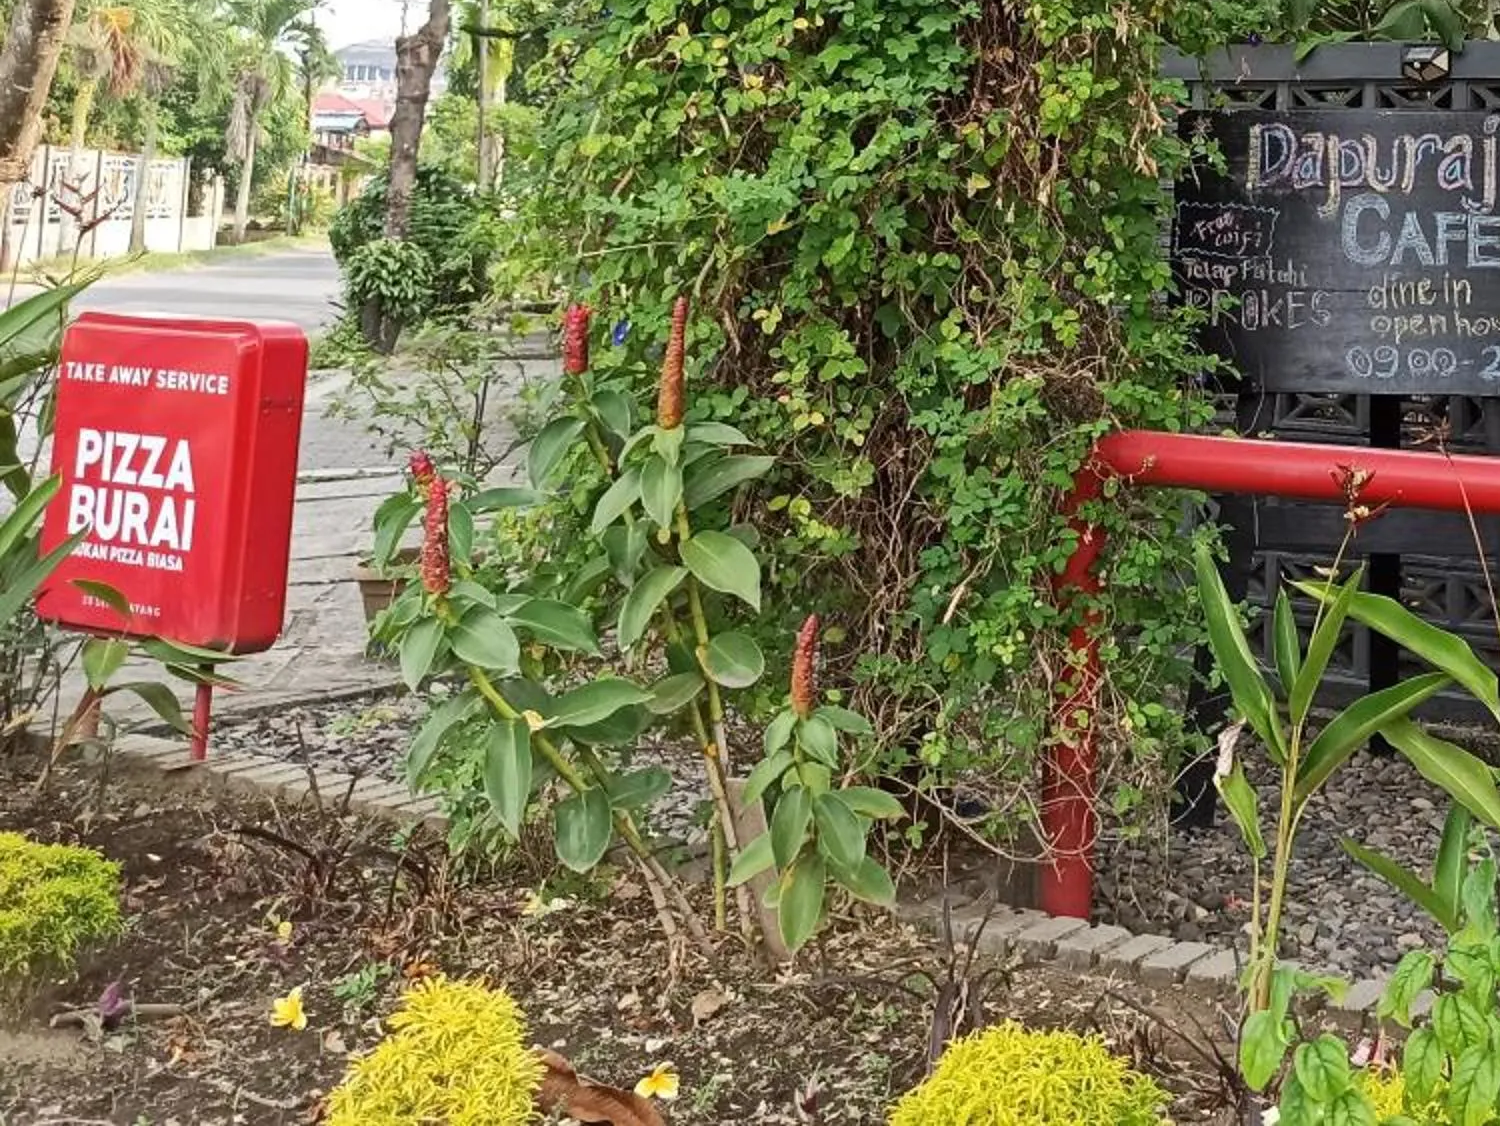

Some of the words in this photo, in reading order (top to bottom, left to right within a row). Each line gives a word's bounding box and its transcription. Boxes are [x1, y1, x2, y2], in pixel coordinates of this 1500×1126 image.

[1368, 272, 1437, 309] dine
[1443, 271, 1471, 307] in
[1370, 312, 1447, 345] open
[66, 362, 105, 382] TAKE
[109, 367, 152, 387] AWAY
[156, 370, 229, 394] SERVICE
[75, 428, 195, 492] PIZZA
[68, 484, 197, 551] BURAI
[110, 547, 143, 566] PIZZA
[147, 552, 183, 571] BIASA
